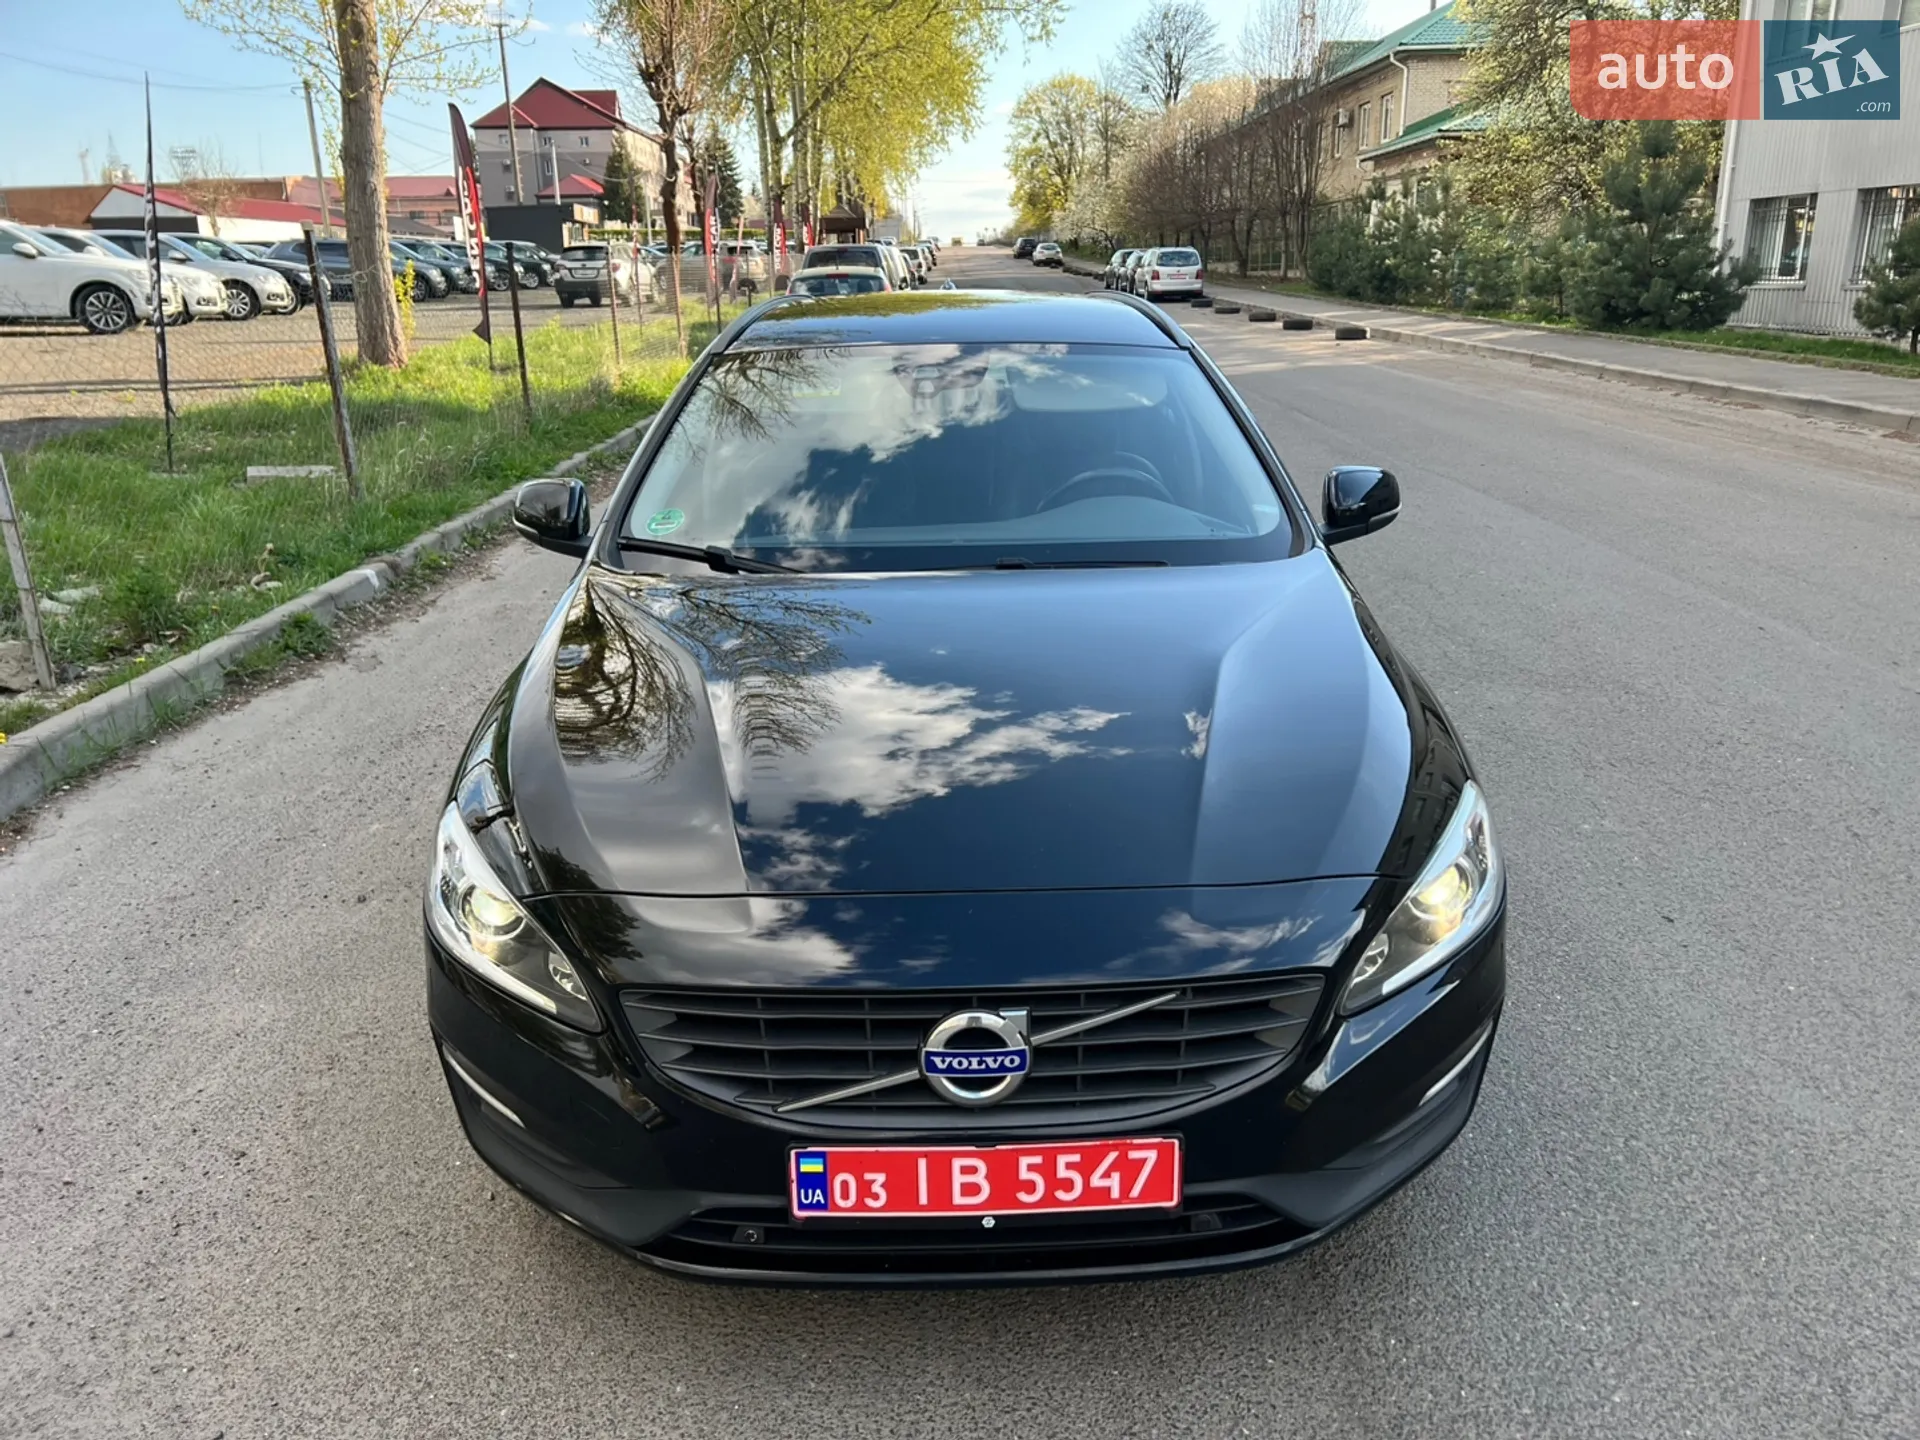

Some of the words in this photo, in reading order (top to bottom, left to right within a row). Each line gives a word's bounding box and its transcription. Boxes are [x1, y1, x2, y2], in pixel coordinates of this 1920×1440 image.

[930, 1055, 1020, 1070] VOLVO
[833, 1172, 888, 1208] 03
[917, 1157, 991, 1206] IB
[1016, 1150, 1158, 1204] 5547
[801, 1189, 825, 1205] UA
